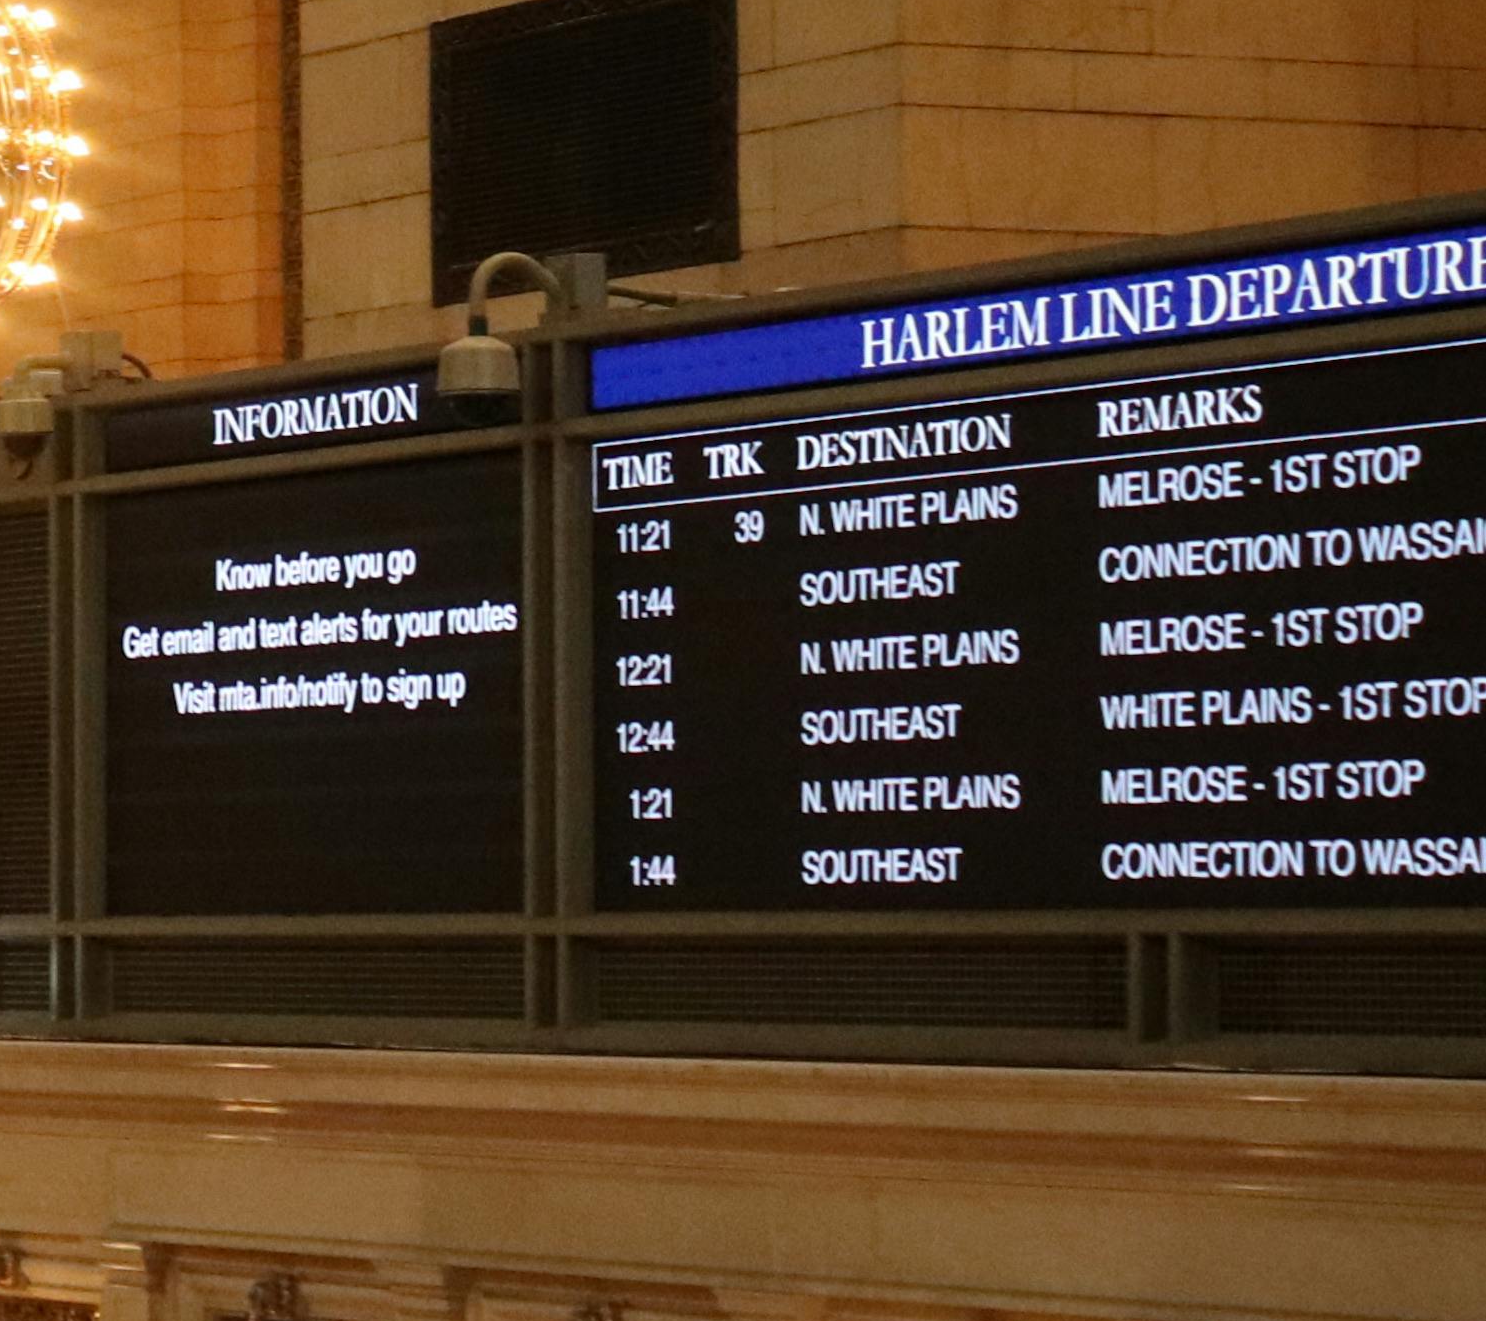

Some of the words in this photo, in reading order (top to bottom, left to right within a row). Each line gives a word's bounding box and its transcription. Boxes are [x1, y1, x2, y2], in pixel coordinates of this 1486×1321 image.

[861, 298, 1049, 369] HARLEM
[1059, 280, 1175, 343] LINE
[213, 383, 418, 445] INFORMATION
[603, 452, 673, 490] TIME
[703, 441, 764, 479] TRK
[796, 414, 1013, 470] DESTINATION
[1096, 385, 1263, 437] REMARKS
[617, 520, 670, 553] 11:21
[735, 511, 764, 543] 39
[800, 504, 825, 536] N.
[830, 494, 915, 532] WHITE
[922, 484, 1018, 524] PLAINS
[1099, 462, 1243, 508] MELROSE
[1270, 454, 1327, 492] 1ST
[1334, 445, 1421, 488] STOP
[216, 559, 272, 591] Know
[275, 551, 341, 586] before
[344, 553, 383, 588] you
[387, 549, 416, 584] go
[617, 587, 674, 619] 11:44
[800, 561, 960, 606] SOUTHEAST
[1099, 534, 1300, 582] CONNECTION
[1306, 529, 1352, 566] TO
[1358, 518, 1486, 562] WASSAI
[123, 626, 159, 658] Get
[161, 621, 214, 656] email
[218, 618, 256, 651] and
[259, 616, 297, 648] text
[300, 612, 358, 645] alerts
[361, 608, 392, 640] for
[394, 610, 444, 647] your
[447, 600, 517, 634] routes
[616, 654, 671, 686] 12:21
[801, 643, 826, 674] N.
[831, 636, 917, 672] WHITE
[923, 629, 1019, 666] PLAINS
[1101, 613, 1245, 656] MELROSE
[1272, 608, 1329, 647] 1ST
[1335, 602, 1423, 643] STOP
[173, 681, 216, 714] Visit
[219, 672, 358, 713] mta.info/notify
[360, 673, 383, 703] to
[387, 668, 432, 709] sign
[437, 672, 466, 707] up
[617, 721, 675, 753] 12:44
[801, 704, 961, 745] SOUTHEAST
[1100, 692, 1195, 729] WHITE
[1203, 687, 1312, 725] PLAINS
[1339, 682, 1398, 720] 1ST
[1404, 677, 1486, 718] STOP
[630, 788, 672, 819] 1:21
[802, 782, 827, 813] N.
[832, 778, 918, 812] WHITE
[924, 774, 1020, 809] PLAINS
[1102, 766, 1247, 804] MELROSE
[1274, 763, 1331, 801] 1ST
[1337, 760, 1425, 799] STOP
[630, 856, 676, 885] 1:44
[802, 847, 962, 884] SOUTHEAST
[1102, 840, 1303, 879] CONNECTION
[1309, 839, 1355, 876] TO
